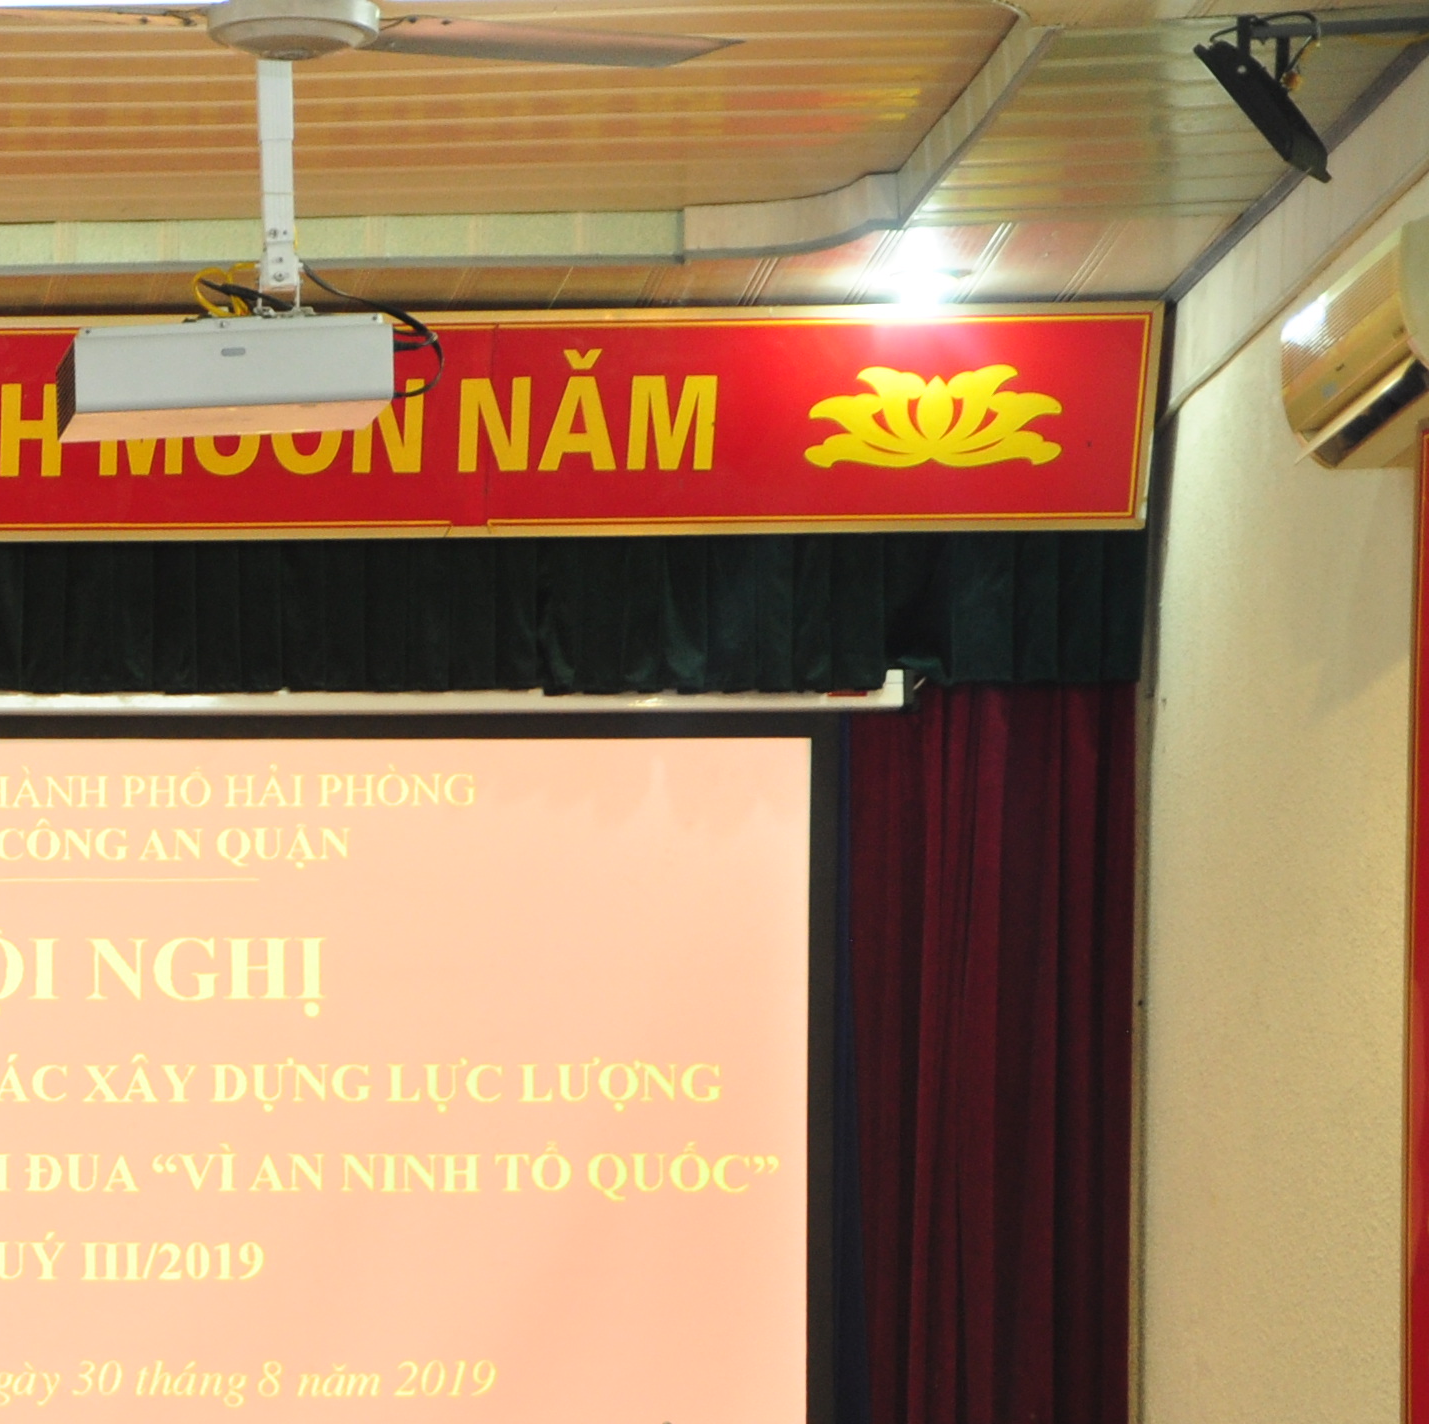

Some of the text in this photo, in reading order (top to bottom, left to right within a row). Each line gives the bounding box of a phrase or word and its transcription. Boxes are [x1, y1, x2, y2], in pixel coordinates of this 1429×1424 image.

[457, 348, 717, 473] NĂM
[122, 766, 211, 808] PHỐ
[225, 764, 303, 808] HẢI
[318, 764, 475, 807] PHÒNG
[139, 827, 202, 861] AN
[217, 822, 350, 868] QUẬN
[86, 936, 326, 1018] NGHỊ
[83, 1053, 196, 1103] XÂY
[210, 1057, 371, 1112] DỰNG
[386, 1058, 502, 1113] LỰC
[519, 1057, 721, 1112] LƯỢNG
[25, 1153, 139, 1192] ĐUA
[249, 1153, 324, 1192] AN
[341, 1153, 481, 1193] NINH
[495, 1142, 572, 1192] TỔ
[81, 1241, 264, 1281] III/2019
[72, 1360, 123, 1396] 30
[136, 1360, 247, 1408] tháng
[258, 1361, 282, 1397] 8
[297, 1364, 381, 1397] năm
[394, 1360, 497, 1397] 2019
